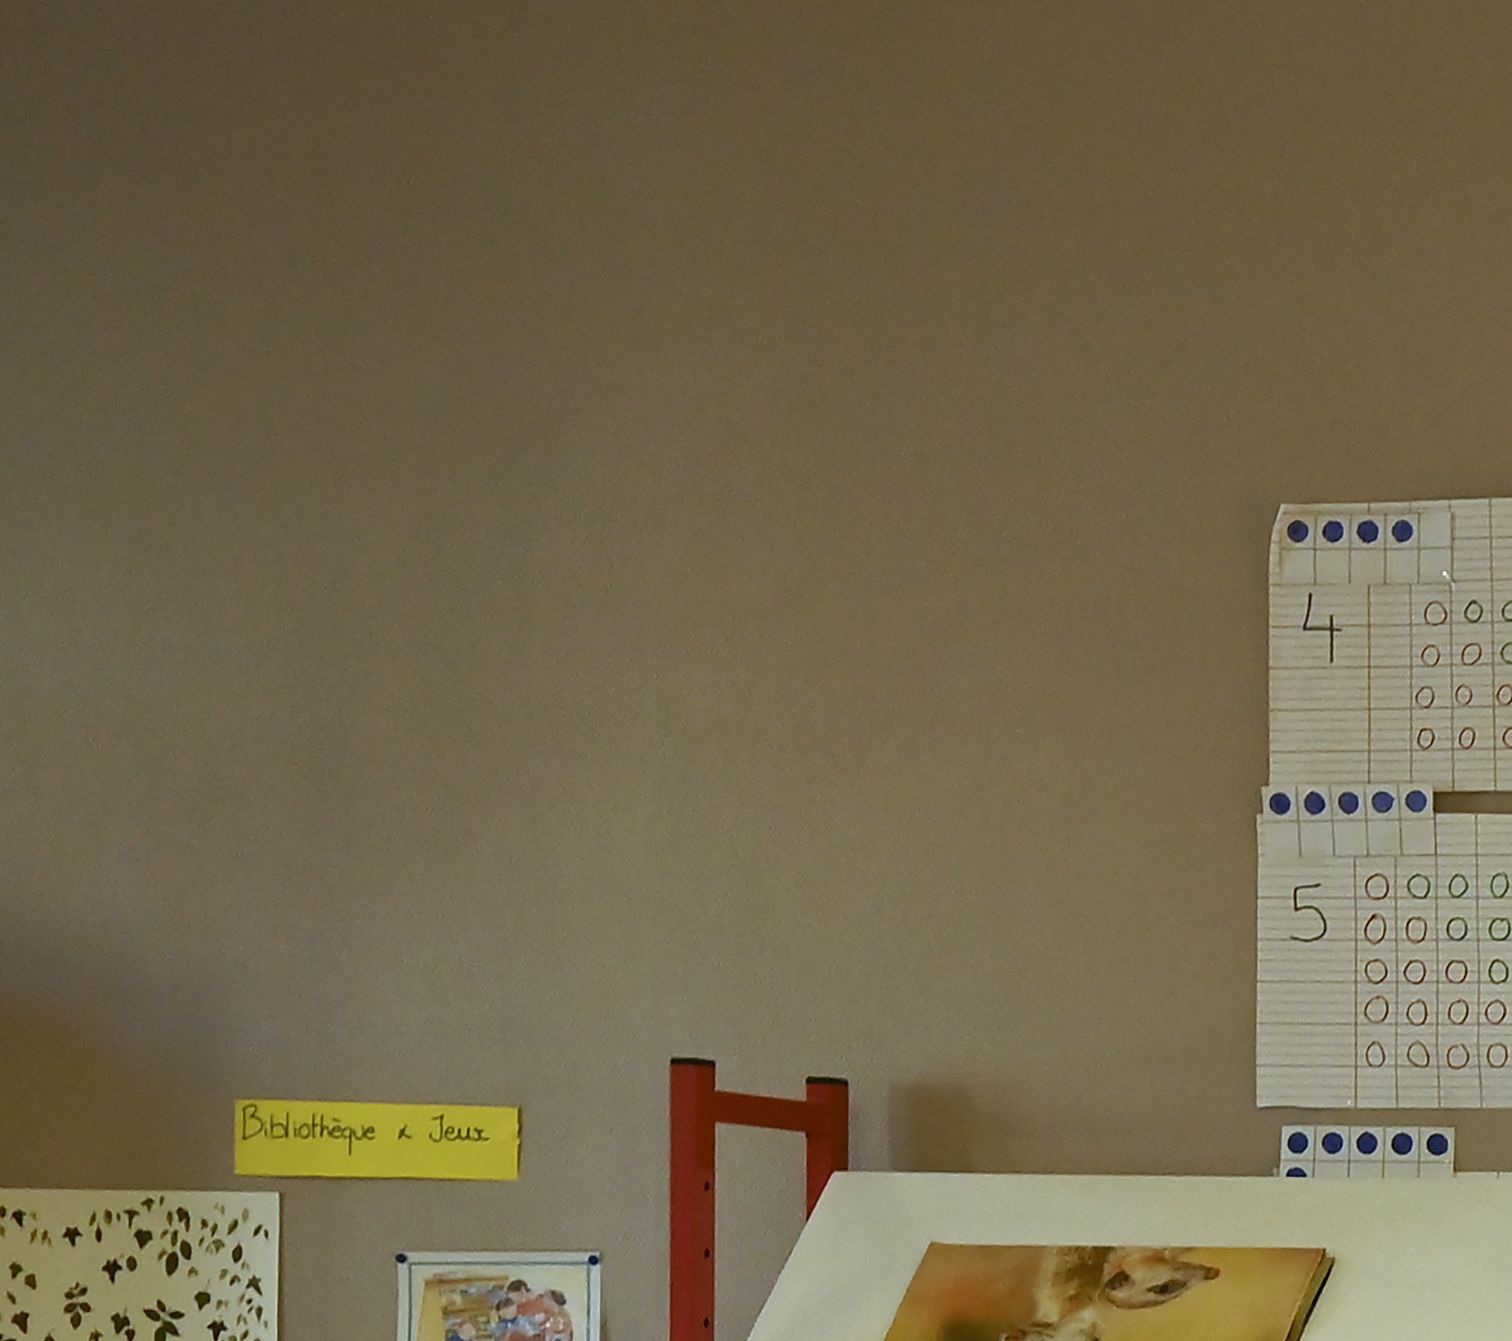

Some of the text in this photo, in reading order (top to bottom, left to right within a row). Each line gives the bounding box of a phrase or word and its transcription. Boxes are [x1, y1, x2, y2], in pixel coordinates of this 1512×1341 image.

[1302, 592, 1342, 662] 4
[1291, 883, 1327, 942] 5
[241, 1104, 375, 1155] Bibliothèque
[429, 1115, 490, 1143] Jeux
